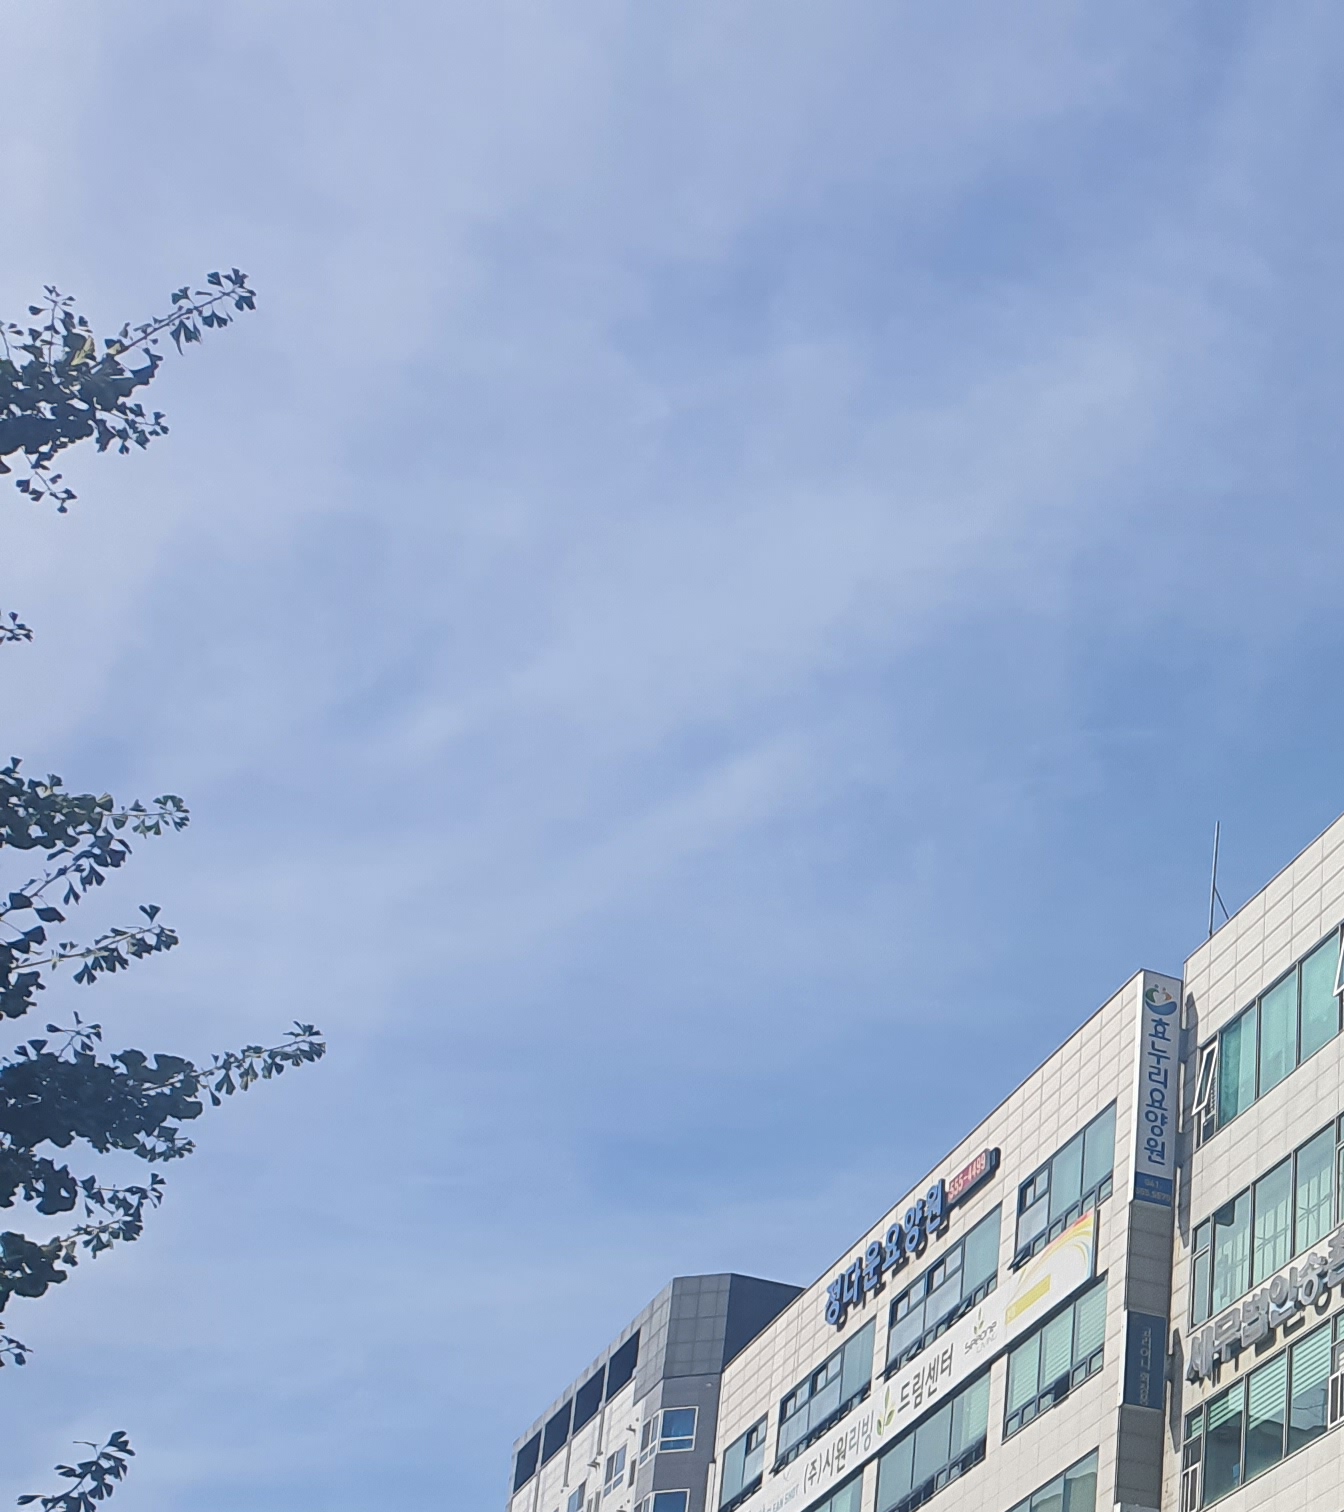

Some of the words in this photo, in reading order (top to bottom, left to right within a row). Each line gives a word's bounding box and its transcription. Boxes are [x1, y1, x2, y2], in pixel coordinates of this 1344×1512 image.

[1144, 1018, 1171, 1166] 효누리요양원
[825, 1178, 946, 1326] 정다운요양원
[897, 1342, 955, 1415] 드림센터
